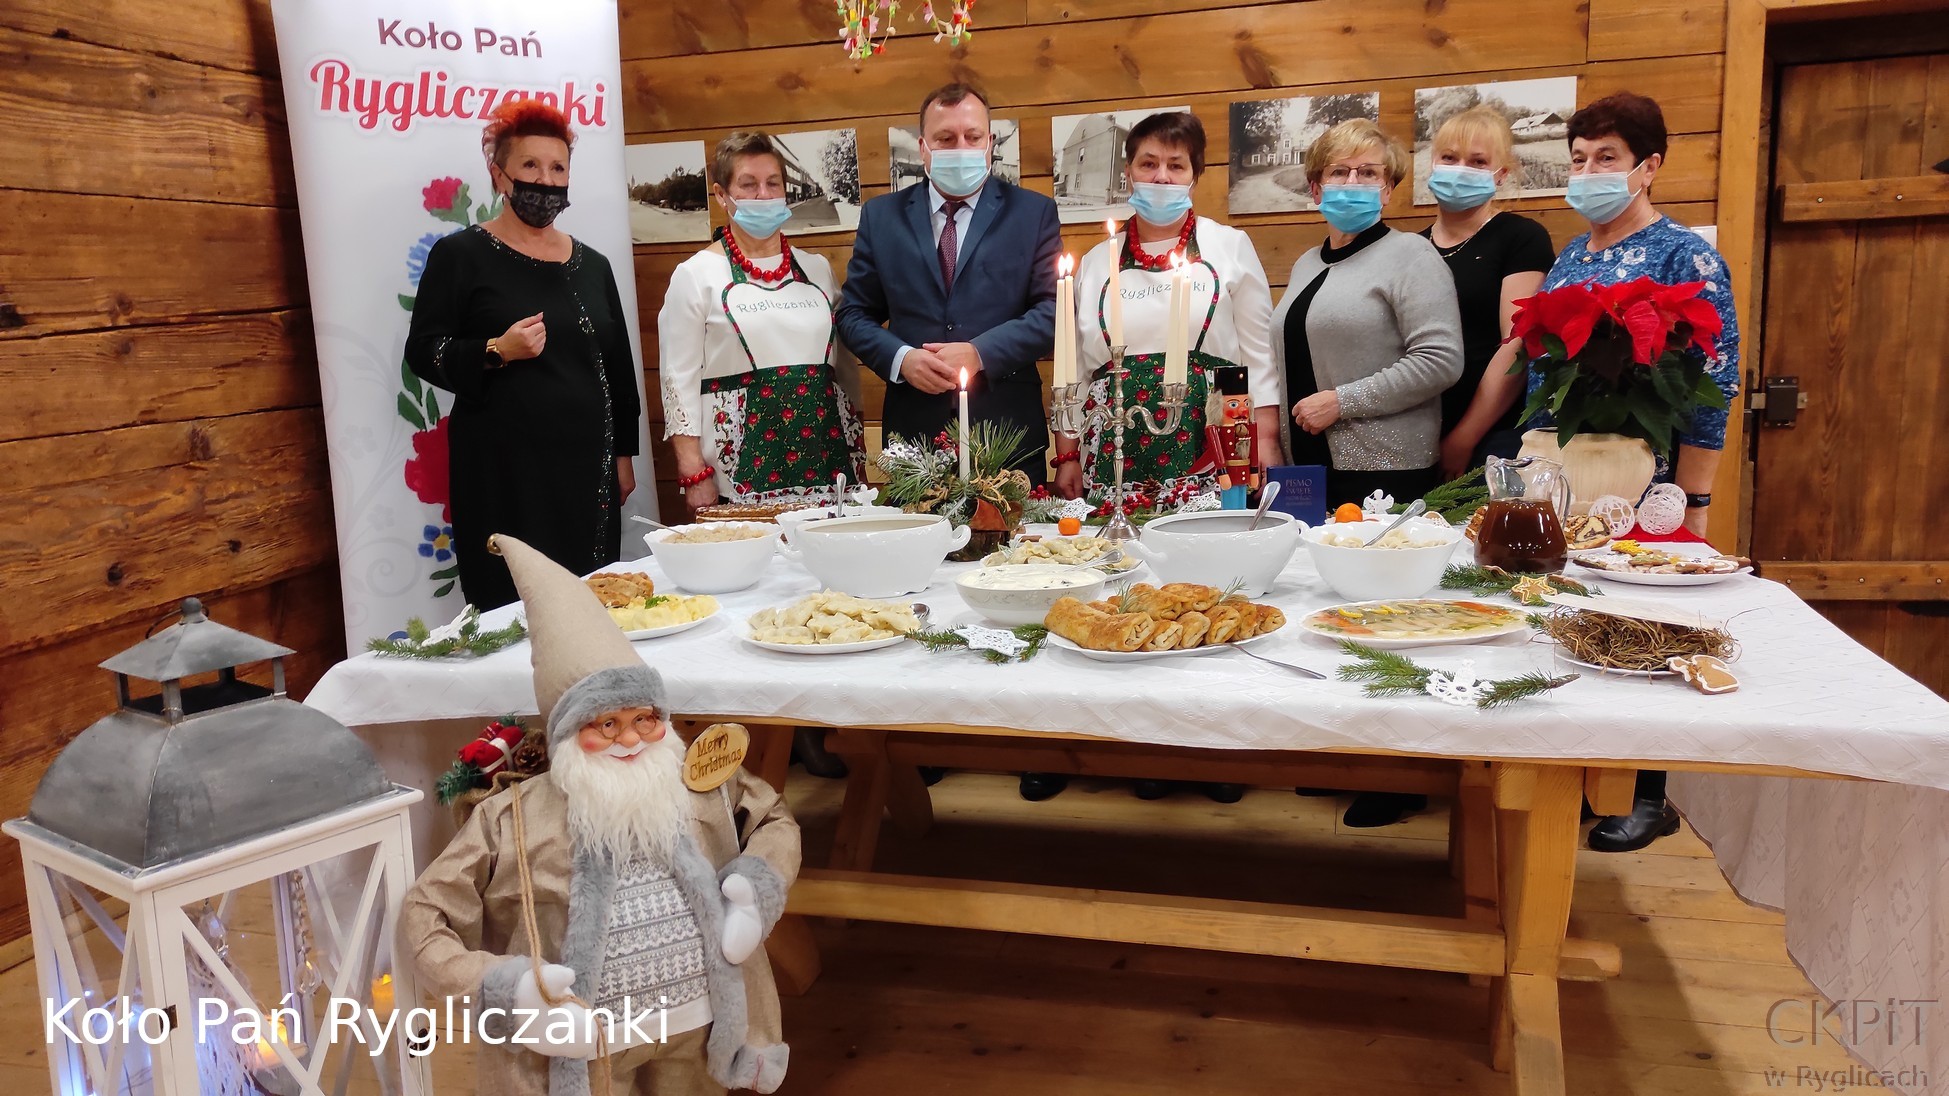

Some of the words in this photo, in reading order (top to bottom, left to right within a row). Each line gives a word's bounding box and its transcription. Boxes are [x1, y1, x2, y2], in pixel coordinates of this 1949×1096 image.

[377, 18, 463, 51] Koło
[474, 27, 542, 58] Pań
[1119, 281, 1206, 299] Rygliczki
[737, 299, 820, 313] Rygliczanki
[696, 733, 728, 758] Merry
[690, 748, 742, 781] Christmas
